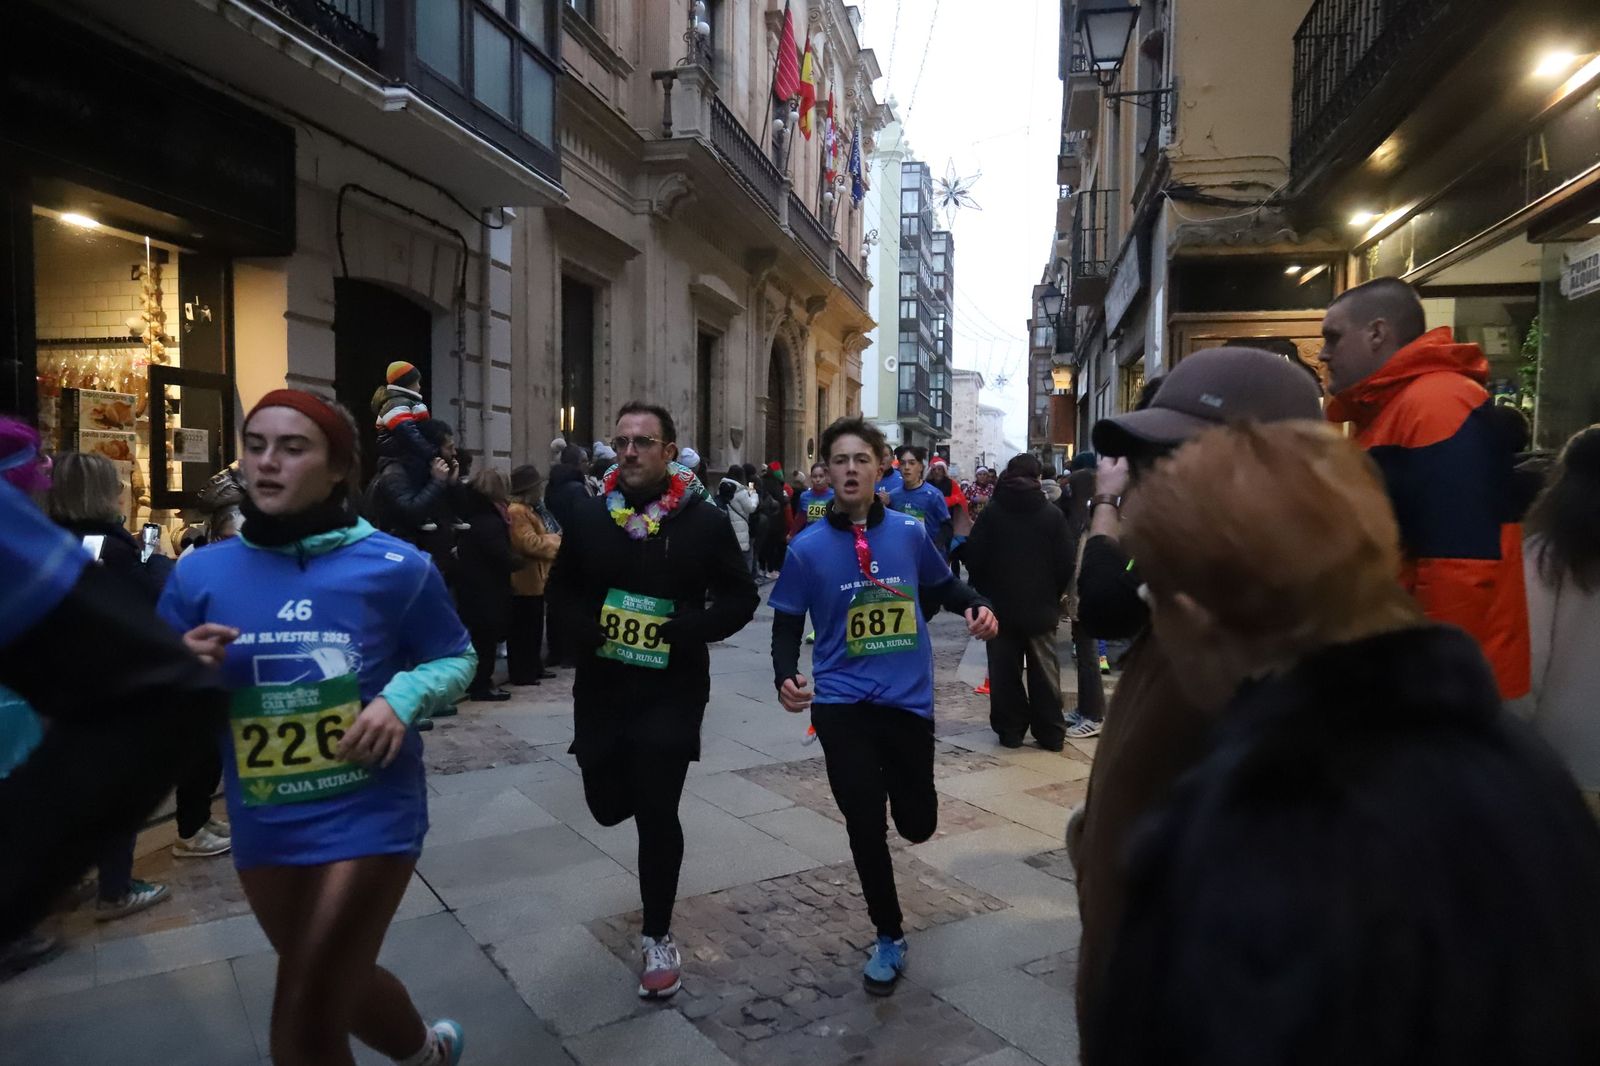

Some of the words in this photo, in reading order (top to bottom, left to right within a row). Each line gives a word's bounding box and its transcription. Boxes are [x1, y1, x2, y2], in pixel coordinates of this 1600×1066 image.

[808, 506, 828, 516] 296
[277, 599, 313, 621] 46
[606, 613, 661, 650] 889
[851, 608, 904, 639] 687
[258, 631, 319, 644] SILVESTRE
[322, 632, 351, 644] 2025
[865, 641, 885, 650] CAJA
[886, 639, 914, 648] RURAL
[616, 648, 634, 659] CAJA
[635, 653, 664, 664] RURAL
[242, 715, 346, 769] 226
[277, 780, 313, 795] CAJA
[317, 769, 370, 790] RURAL
